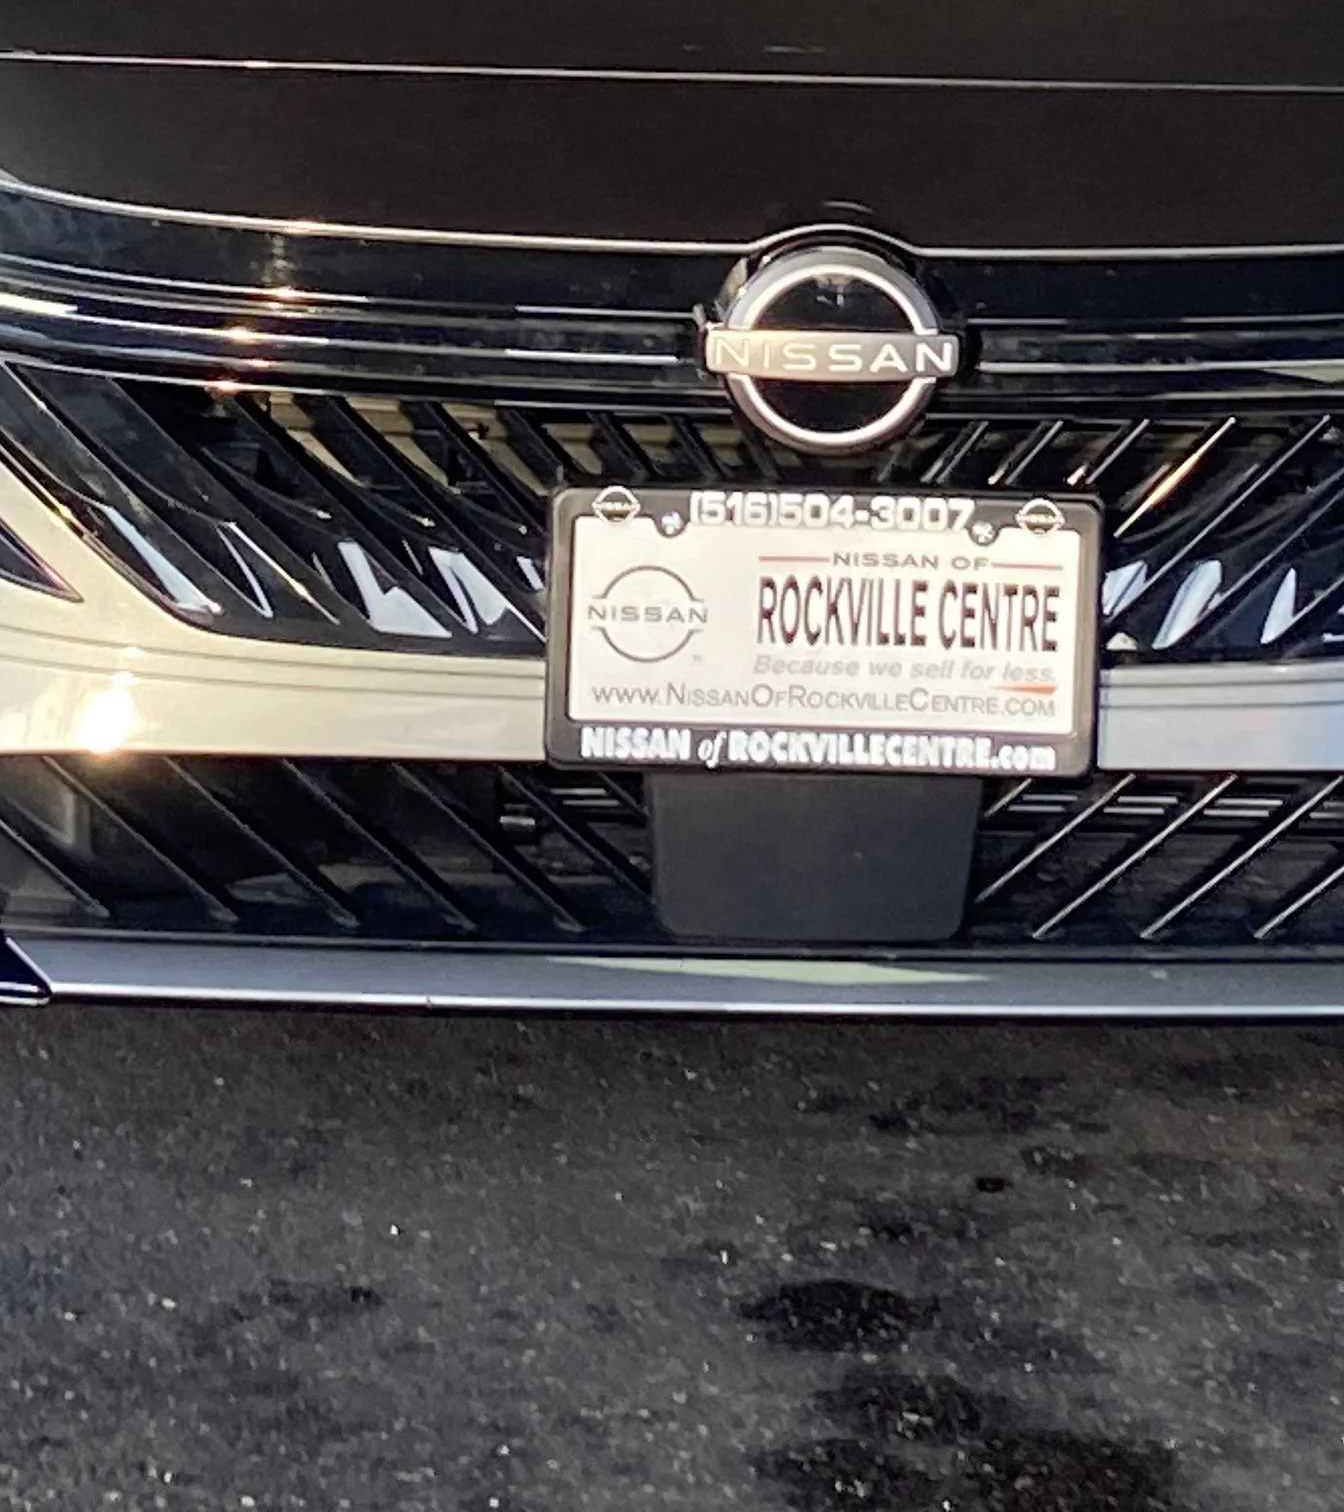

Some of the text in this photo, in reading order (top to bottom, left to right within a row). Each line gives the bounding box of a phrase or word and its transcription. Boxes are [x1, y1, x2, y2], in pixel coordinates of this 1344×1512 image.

[714, 336, 954, 373] NISSAN
[832, 552, 990, 572] NISSAN OF
[587, 604, 709, 624] NISSAN
[756, 573, 1060, 653] ROCKVILLE CENTRE
[753, 653, 860, 677] Because
[868, 660, 903, 677] we
[909, 658, 956, 681] sell
[960, 659, 996, 683] for
[580, 726, 1056, 771] NISSAN of ROCKVILLECENTRE.com
